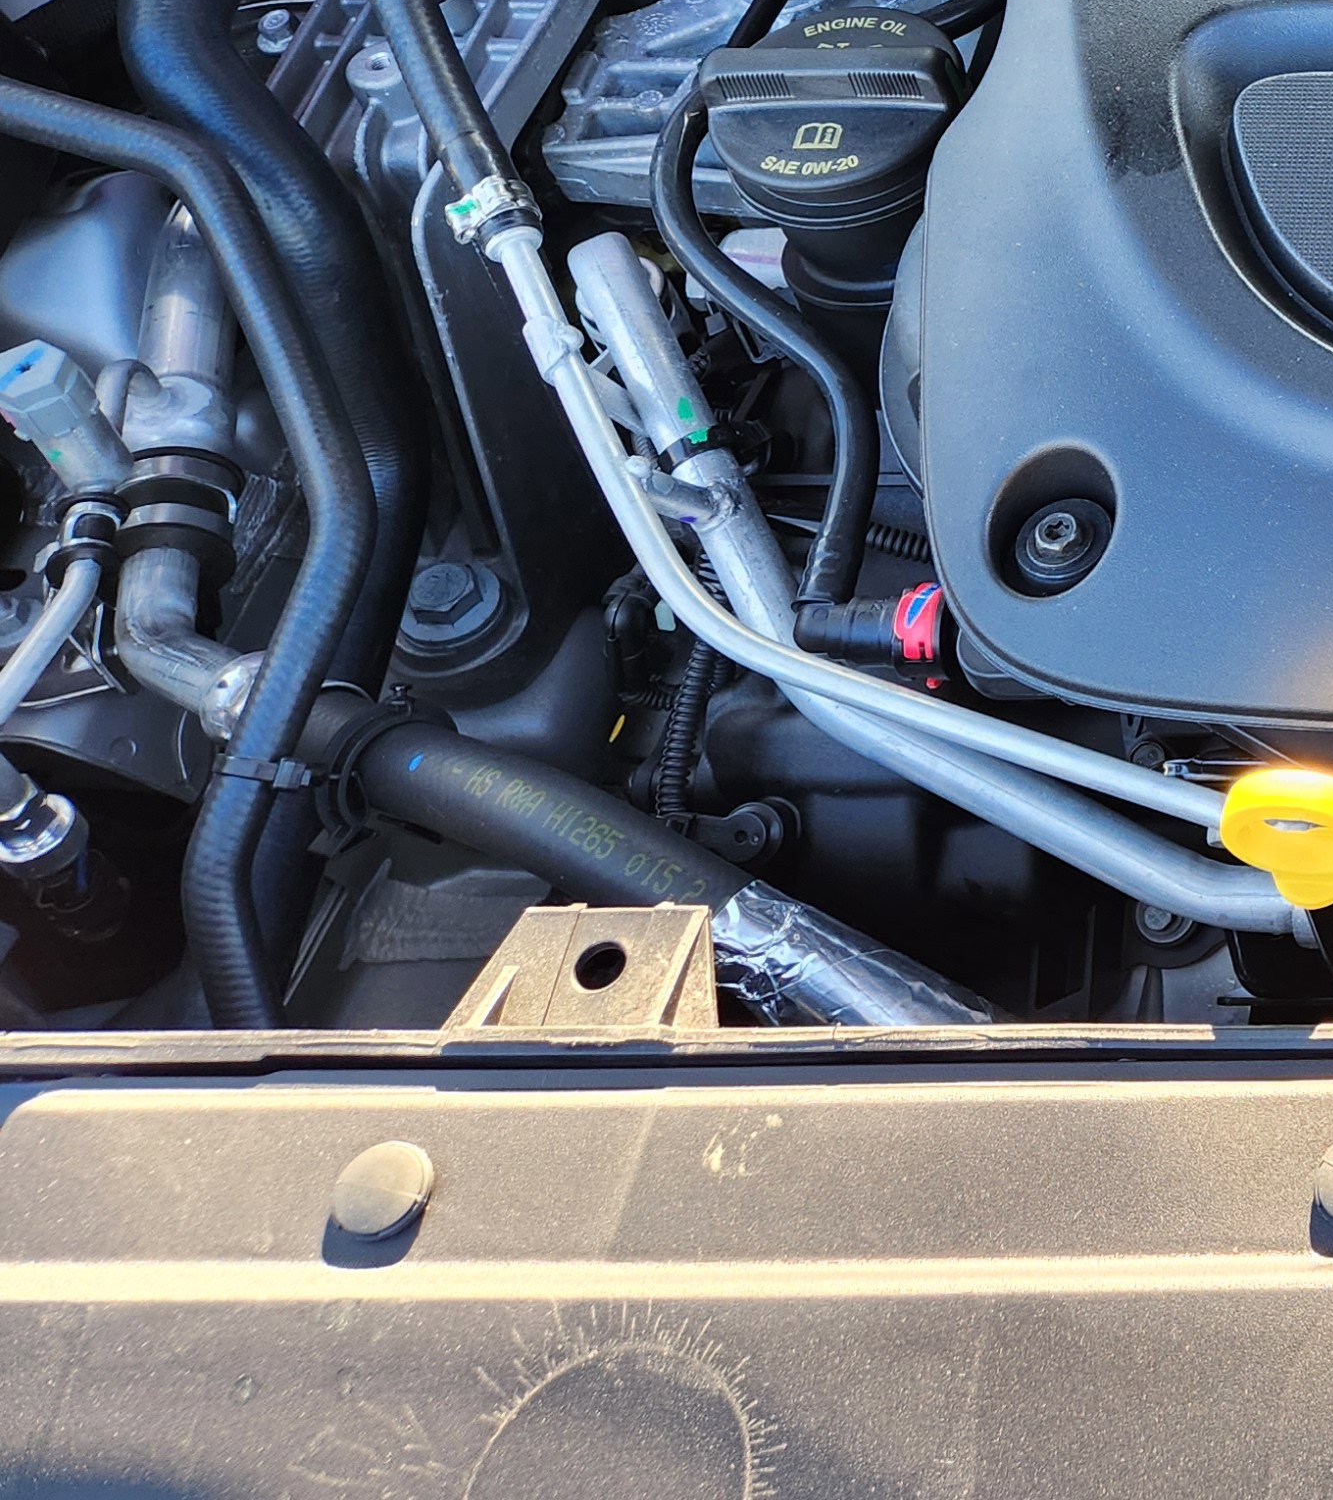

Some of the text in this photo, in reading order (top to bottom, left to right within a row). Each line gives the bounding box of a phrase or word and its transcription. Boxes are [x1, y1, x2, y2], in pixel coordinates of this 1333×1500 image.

[803, 16, 908, 38] ENGINE OIL
[760, 154, 860, 176] SAE 0W-20
[463, 763, 501, 799] HS
[495, 778, 547, 819] R&A
